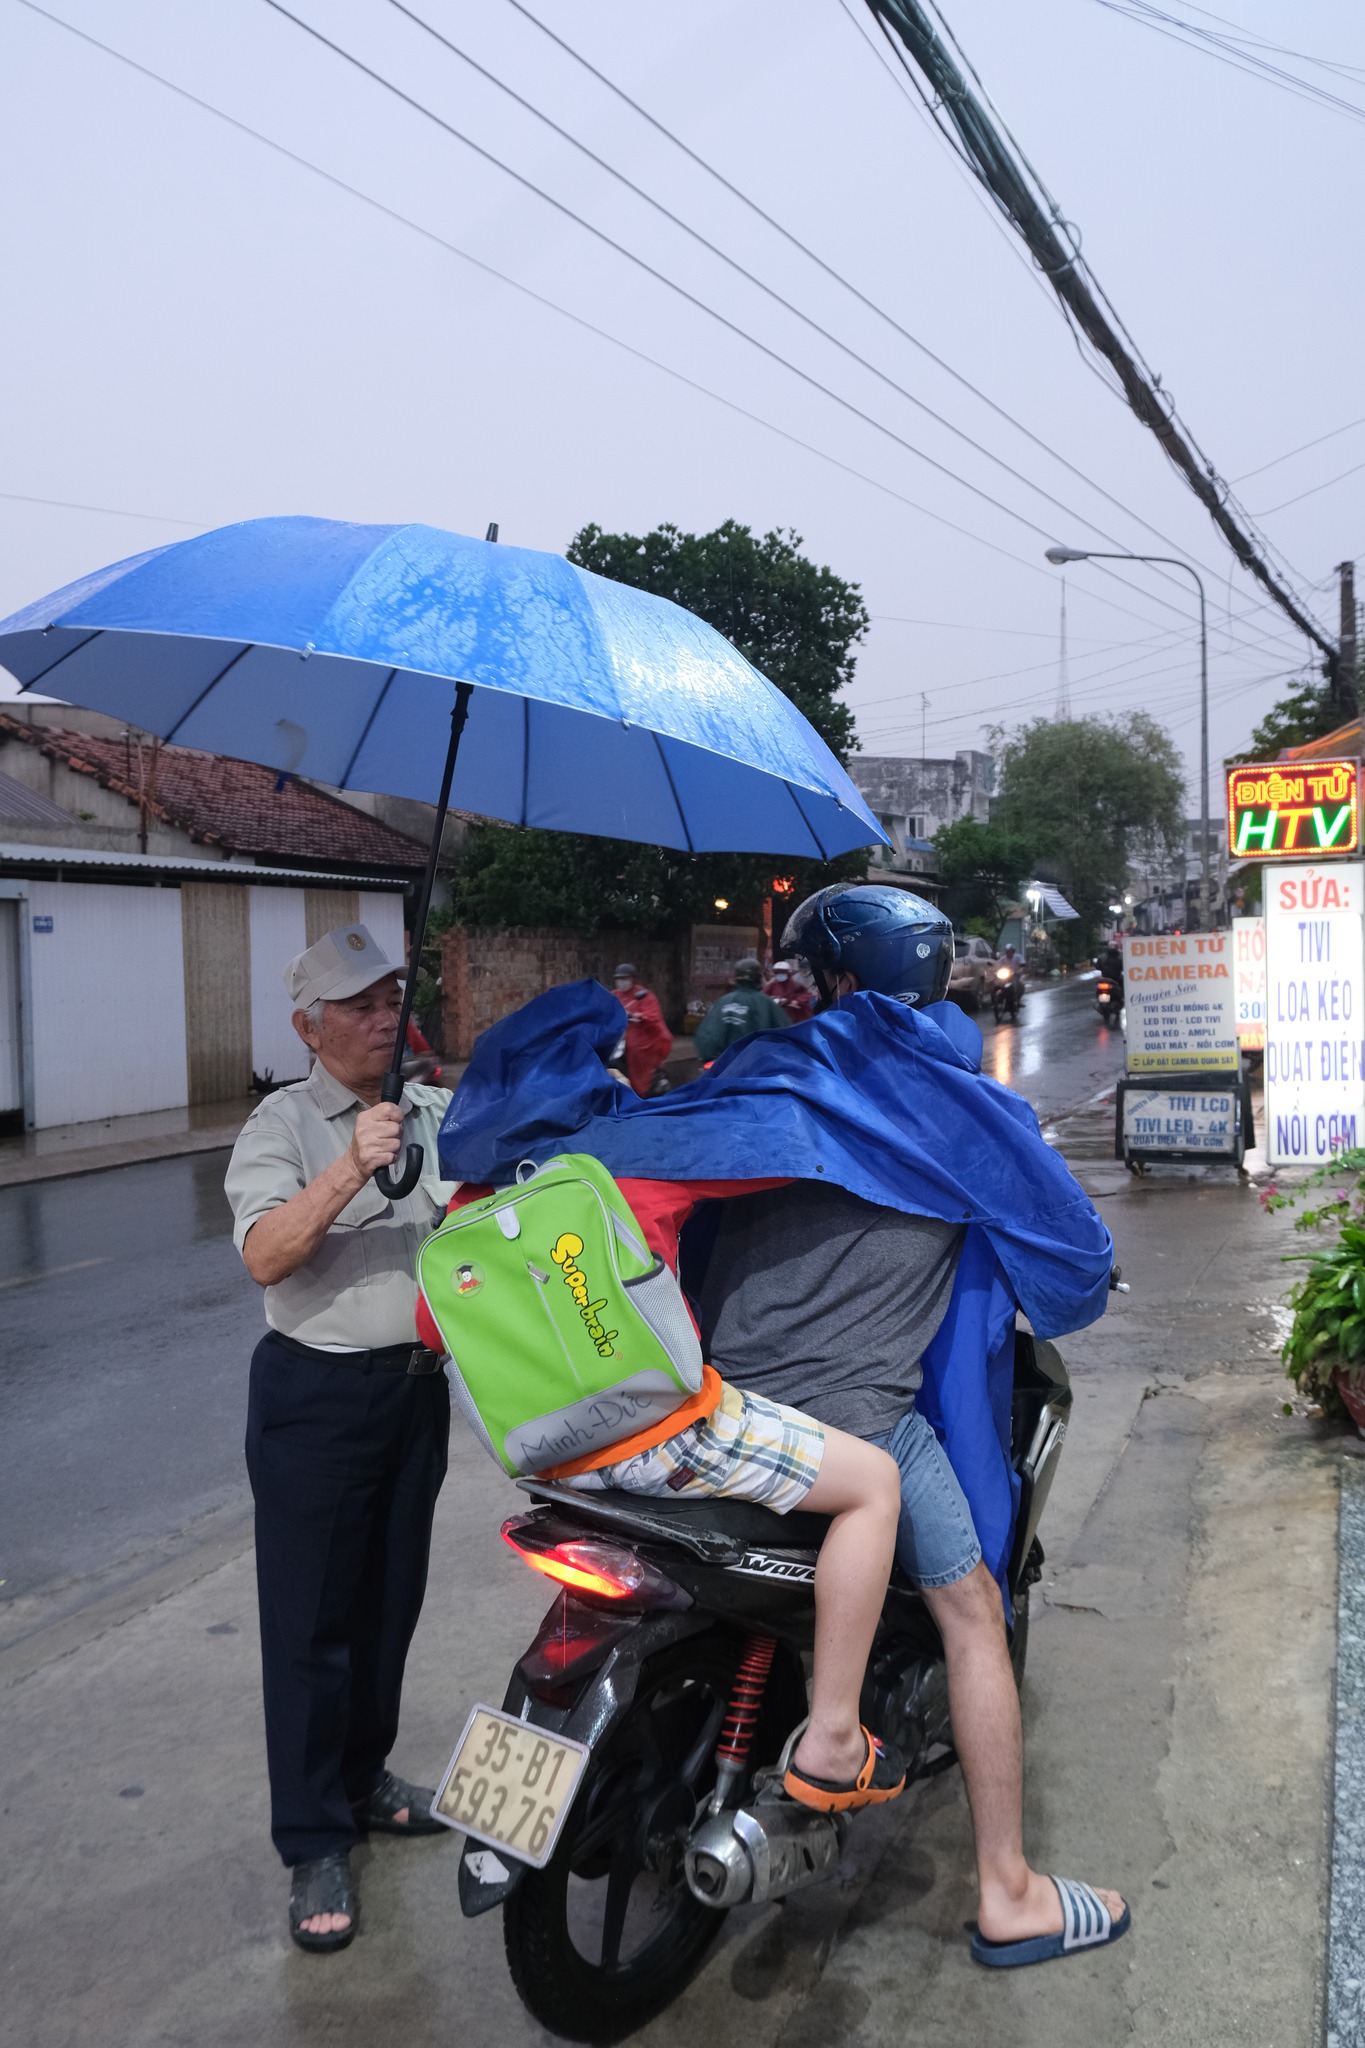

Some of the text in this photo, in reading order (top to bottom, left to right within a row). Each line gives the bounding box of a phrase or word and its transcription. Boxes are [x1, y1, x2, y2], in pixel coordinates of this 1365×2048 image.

[1236, 767, 1349, 810] ĐIỆN TỬ
[1236, 804, 1351, 851] HTV
[1279, 868, 1350, 910] SỬA:
[1131, 938, 1187, 959] ĐIỆN
[1298, 921, 1330, 963] TIVI
[1128, 963, 1229, 982] CAMERA
[1143, 1005, 1159, 1014] TIVI
[1212, 1003, 1224, 1011] 4K
[1277, 980, 1310, 1022] LOA
[1143, 1017, 1160, 1026] LED
[1162, 1016, 1178, 1025] TIVI
[1185, 1016, 1202, 1025] LCD
[1204, 1015, 1221, 1024] TIVI
[1144, 1030, 1161, 1038] LOA
[1187, 1028, 1216, 1037] AMPLI
[1168, 1095, 1230, 1113] TIVI LCD
[1134, 1117, 1161, 1133] TIVI
[1166, 1118, 1194, 1134] LED
[1208, 1120, 1229, 1134] 4K
[550, 1232, 618, 1357] Superbrain
[444, 1767, 555, 1853] 593.76
